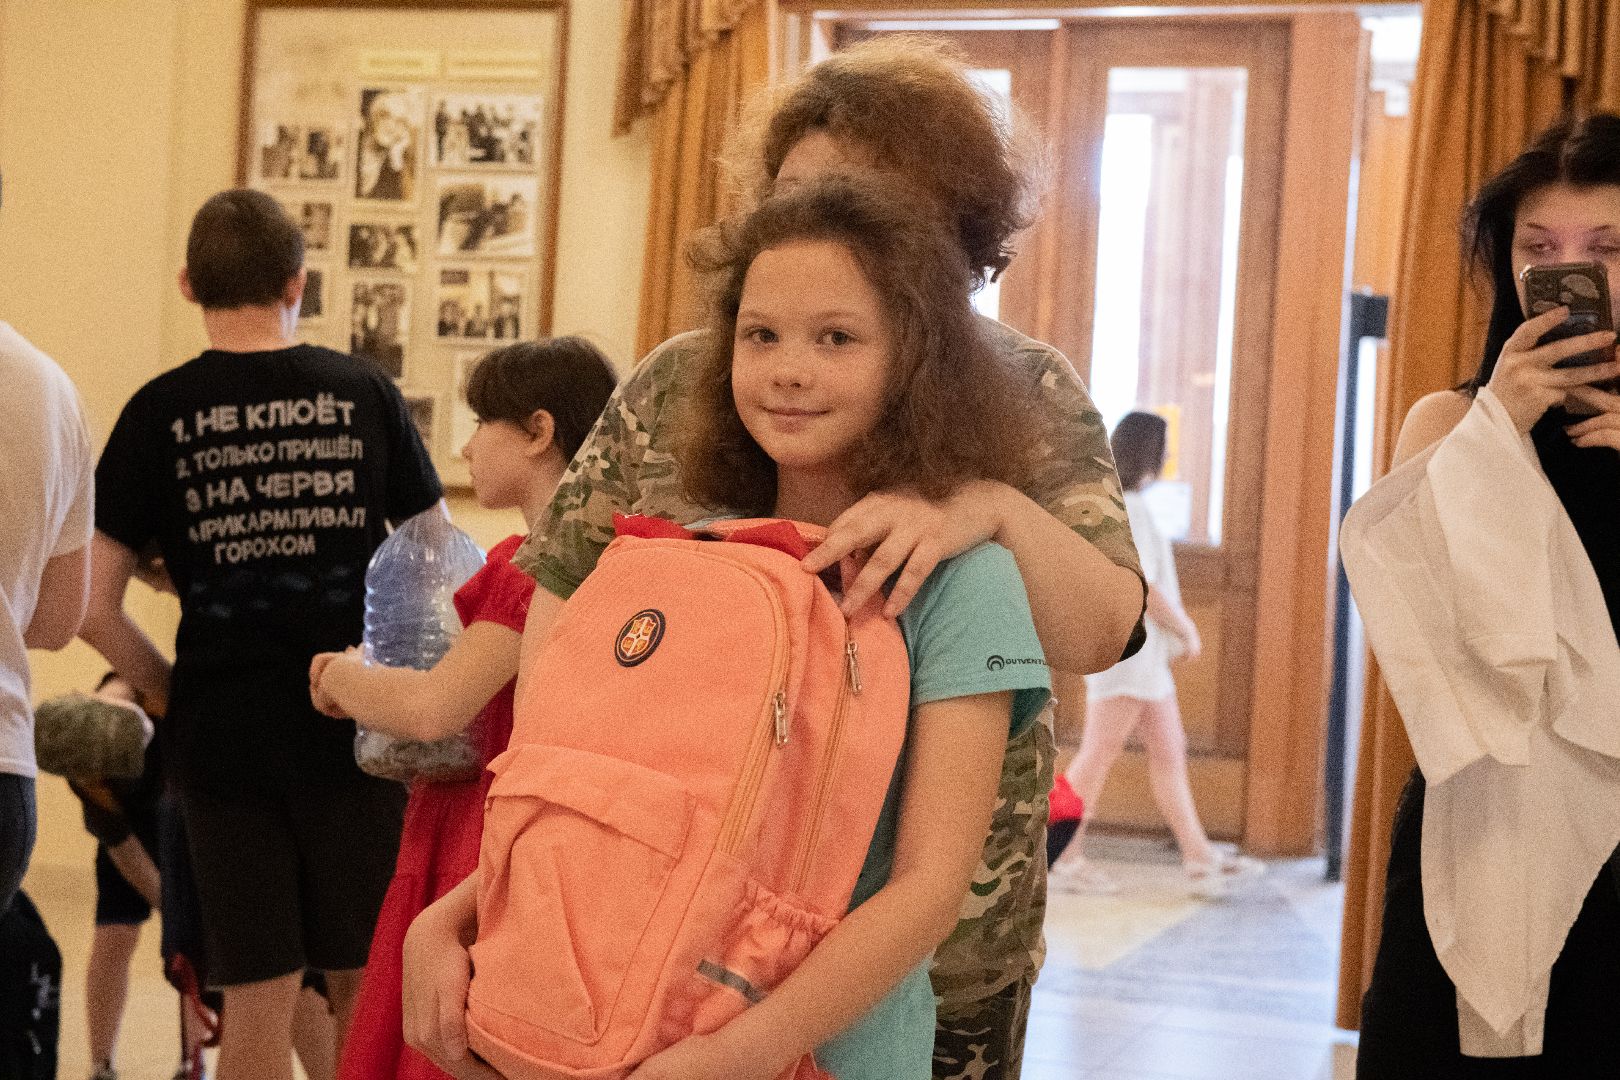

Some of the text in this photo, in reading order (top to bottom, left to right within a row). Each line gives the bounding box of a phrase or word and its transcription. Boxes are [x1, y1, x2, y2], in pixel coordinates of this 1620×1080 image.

[195, 405, 240, 437] НЕ
[245, 392, 355, 429] КЛЮЁТ
[193, 441, 275, 473] ТОЛЬКО
[278, 434, 363, 461] ПРИШЁЛ
[206, 476, 250, 507] НА
[256, 470, 355, 498] ЧЕРВЯ
[215, 534, 316, 565] ГОРОХОМ
